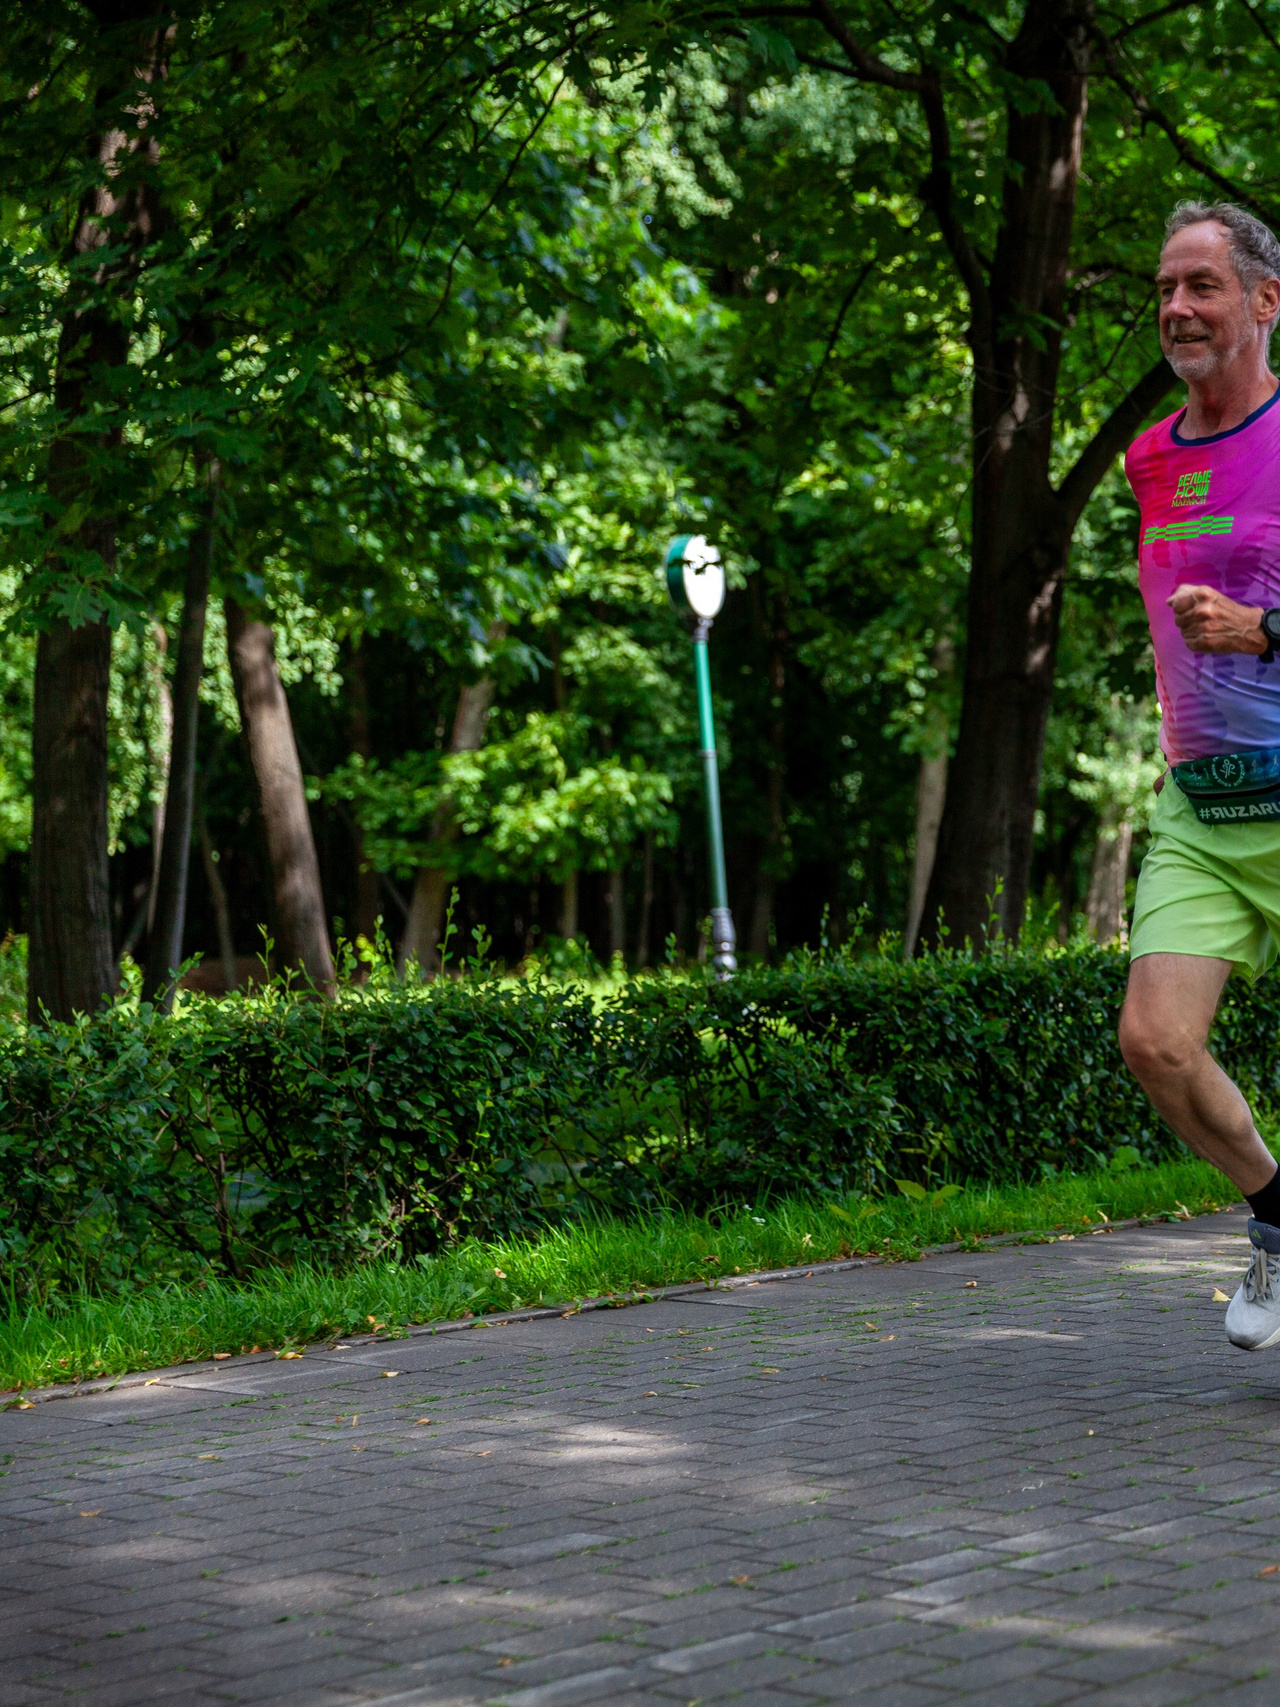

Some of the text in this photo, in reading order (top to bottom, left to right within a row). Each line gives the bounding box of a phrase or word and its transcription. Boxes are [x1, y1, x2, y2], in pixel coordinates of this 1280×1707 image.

[1178, 470, 1212, 487] БЕЛЫЕ
[1173, 484, 1209, 499] НОЧИ
[1171, 497, 1206, 507] МАРАФОН
